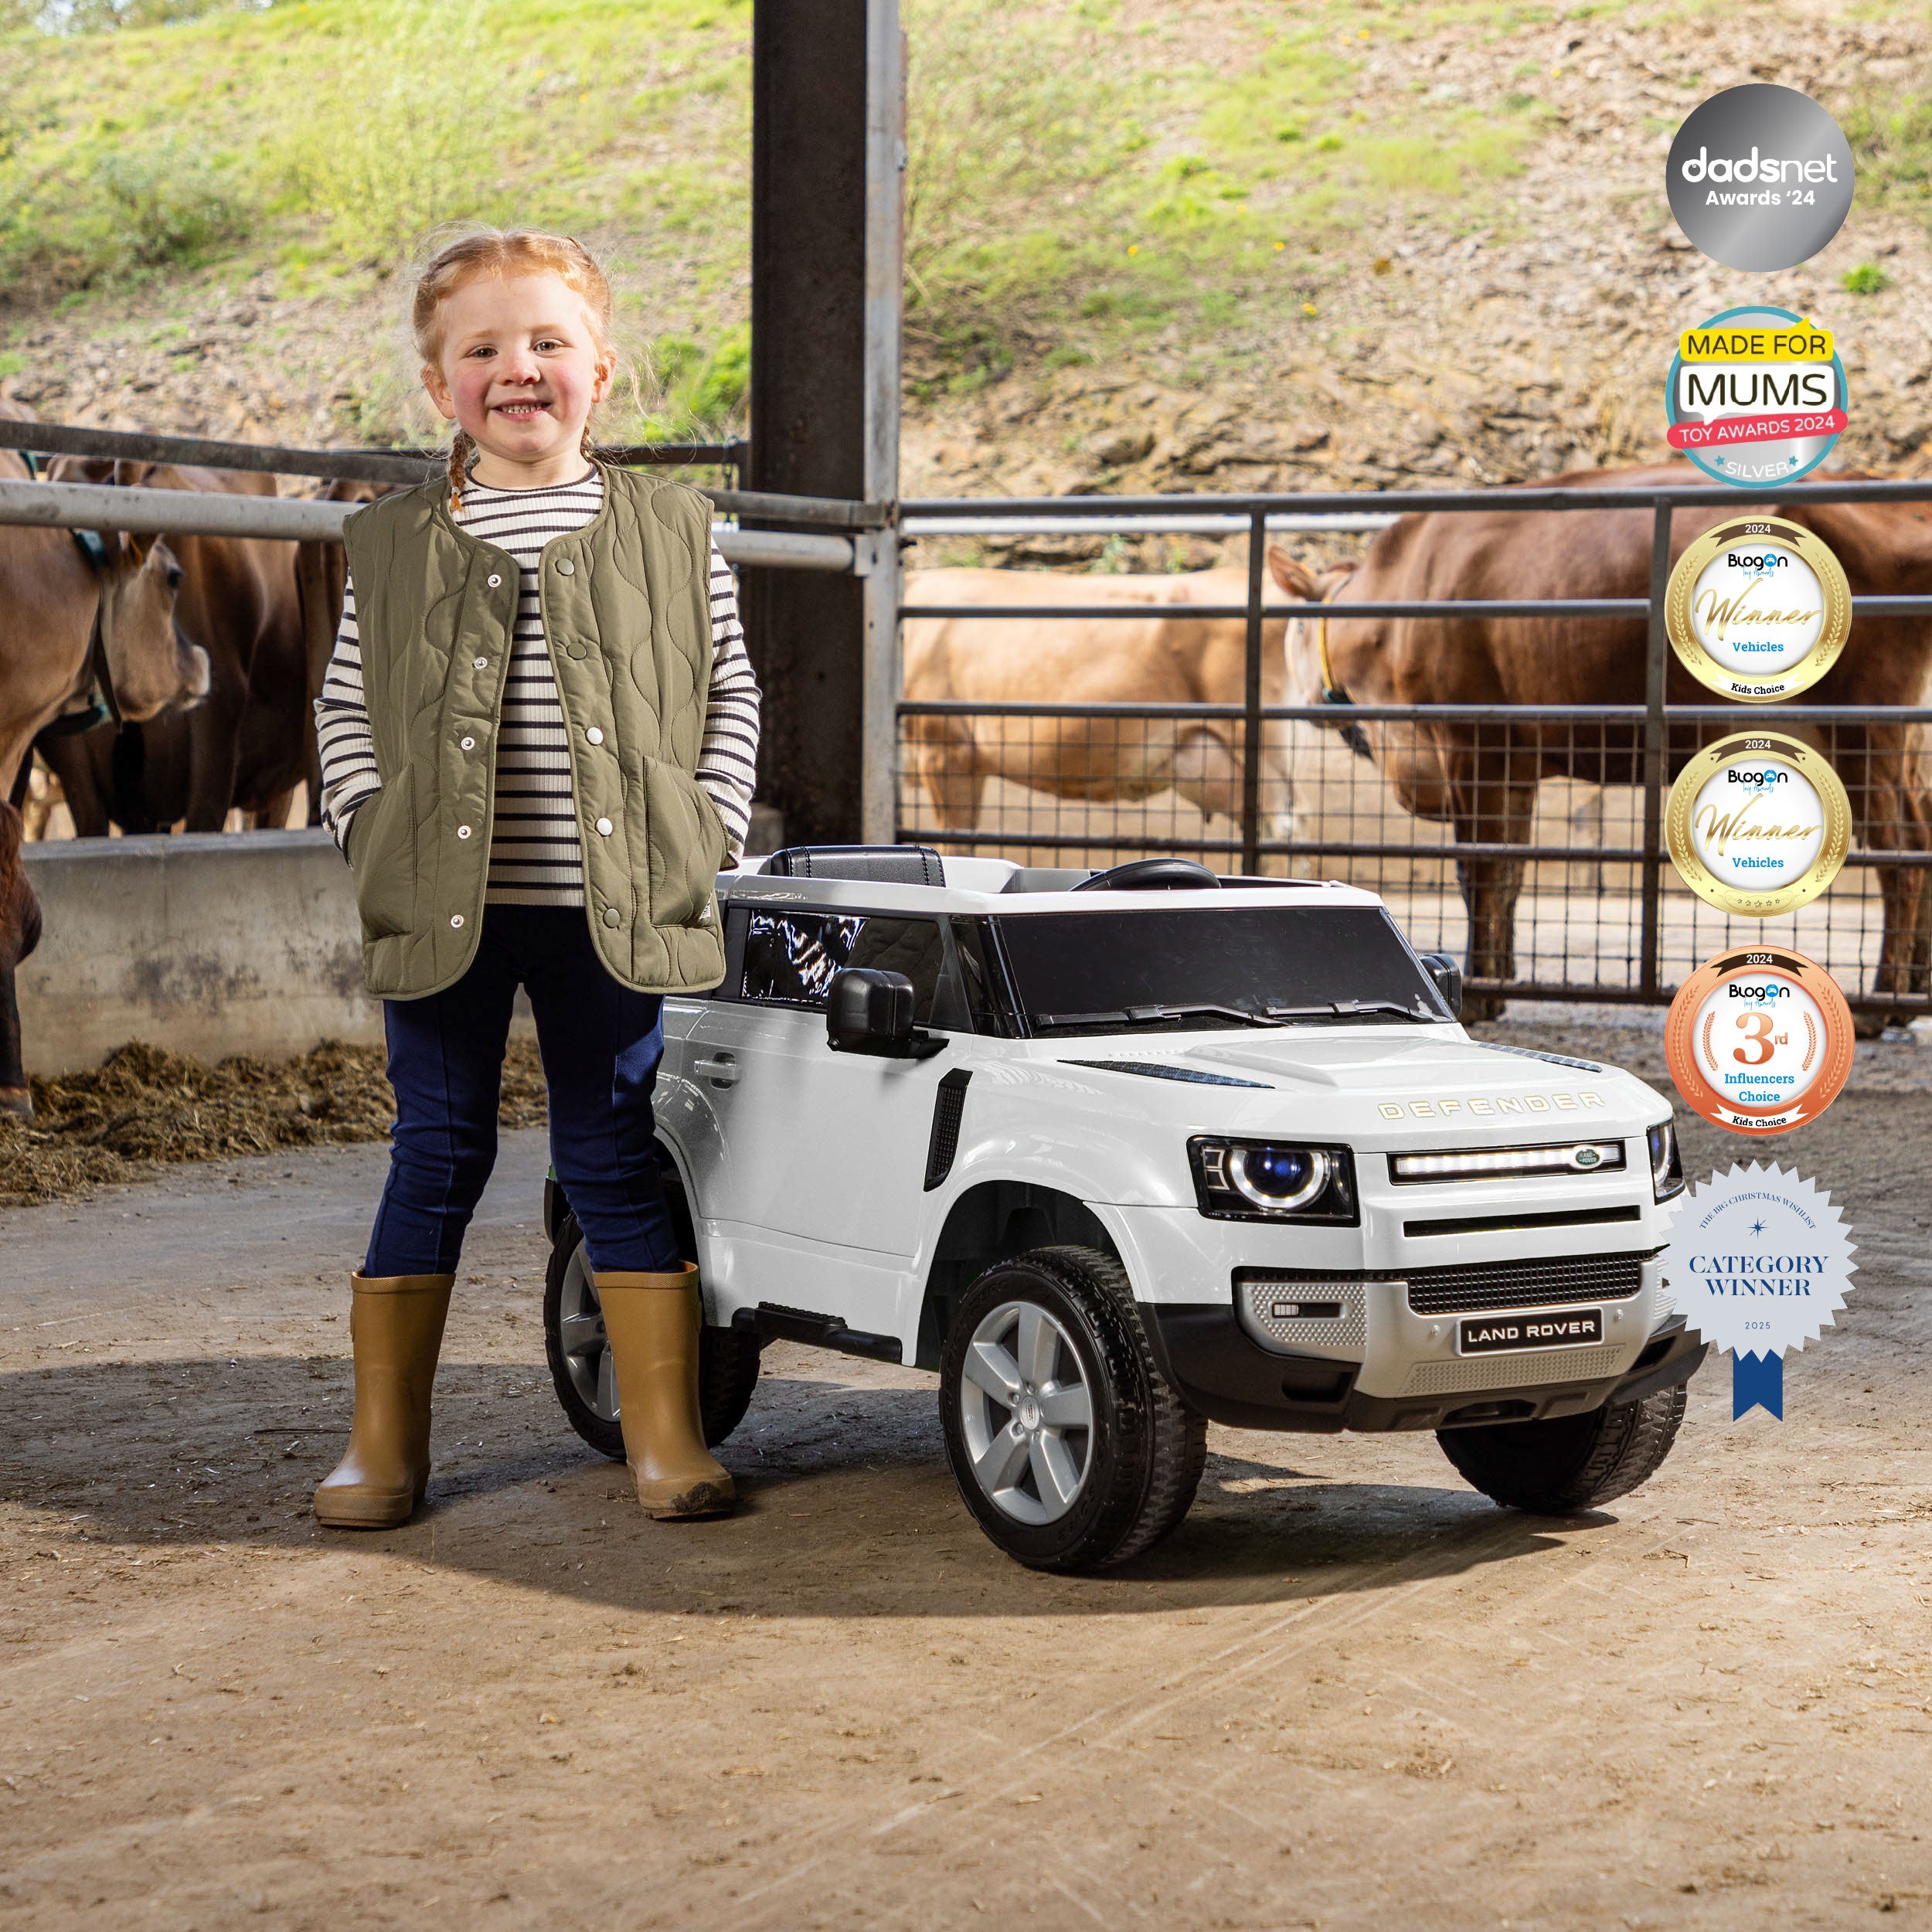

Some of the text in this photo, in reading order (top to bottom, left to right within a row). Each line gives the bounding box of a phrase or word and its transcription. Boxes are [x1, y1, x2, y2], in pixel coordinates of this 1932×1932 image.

[1378, 1091, 1605, 1120] DEFENDER
[1468, 1320, 1595, 1342] LAND ROVER
